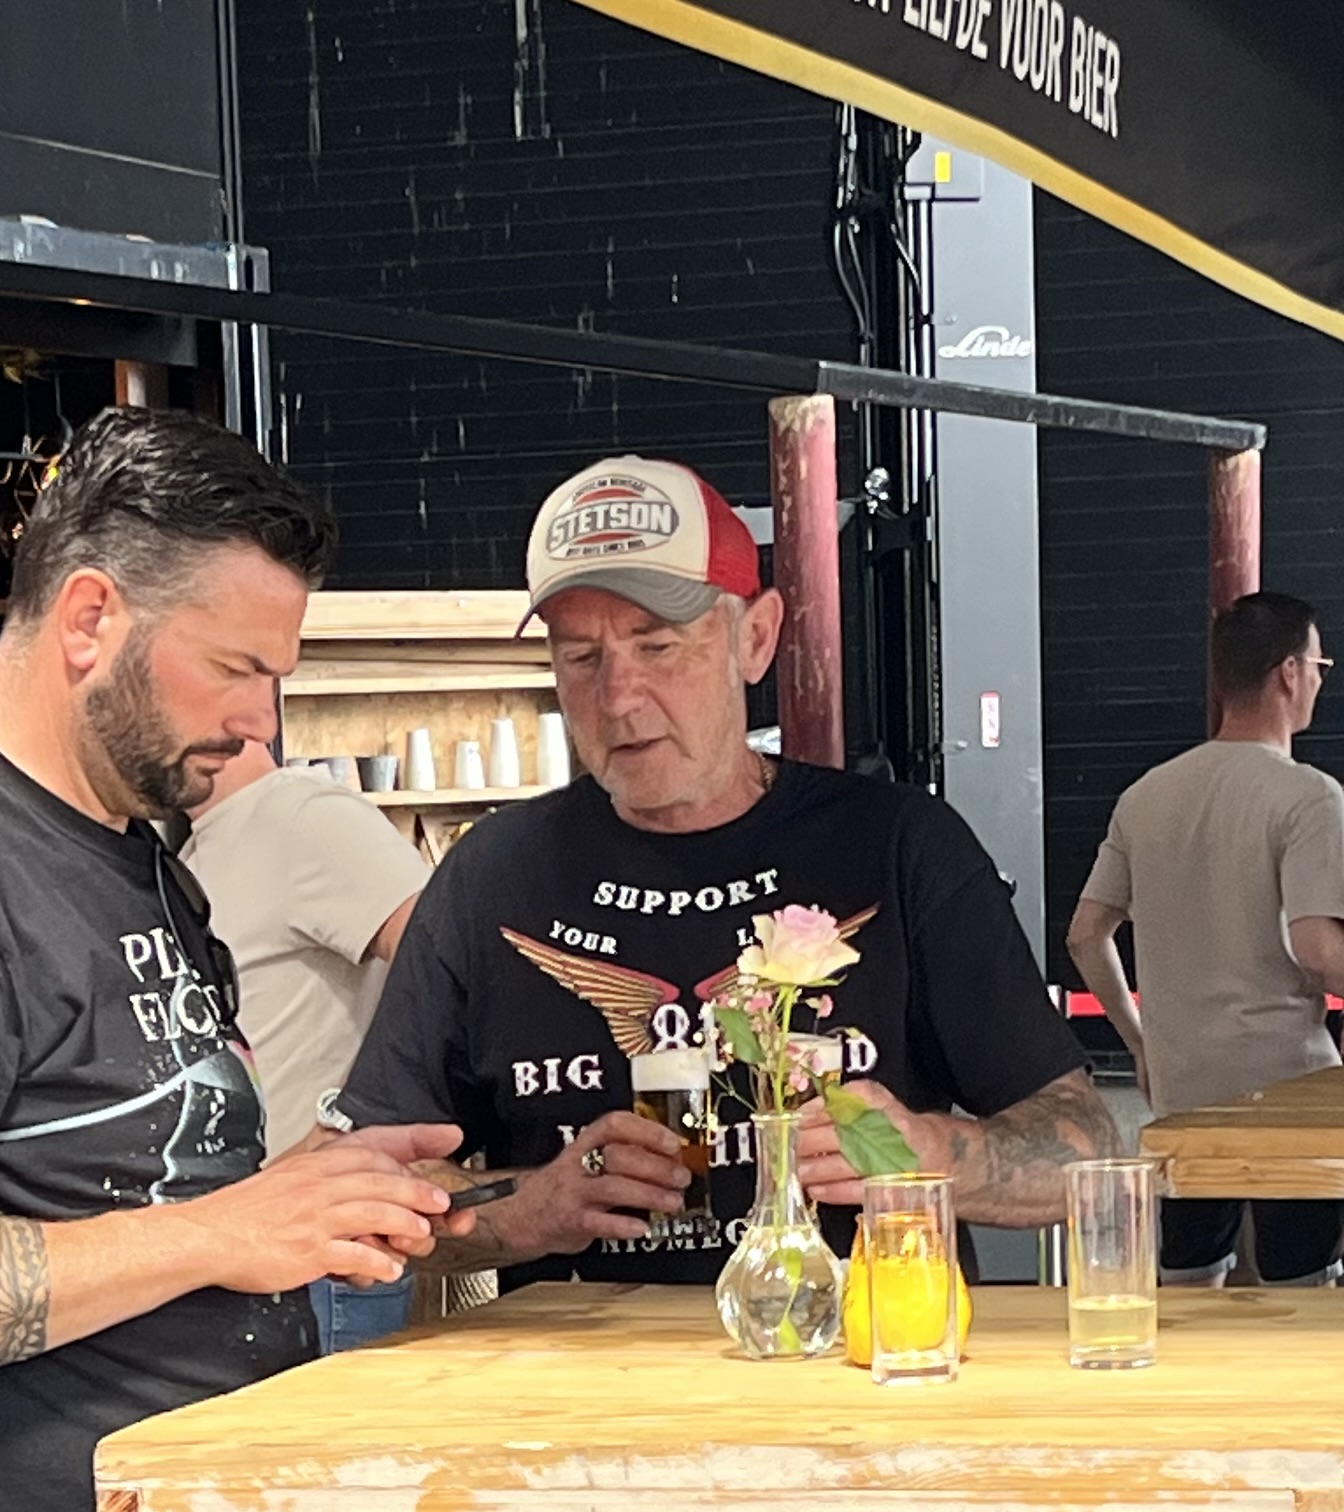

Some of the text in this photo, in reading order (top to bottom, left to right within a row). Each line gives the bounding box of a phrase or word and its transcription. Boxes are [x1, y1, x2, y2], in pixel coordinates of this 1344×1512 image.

[999, 0, 1064, 102] VOOR
[1068, 15, 1120, 139] BIER
[938, 325, 1034, 358] Linde
[549, 502, 672, 550] STETSON
[593, 868, 779, 916] SUPPORT
[548, 920, 618, 956] YOUR
[512, 1053, 603, 1097] BIG
